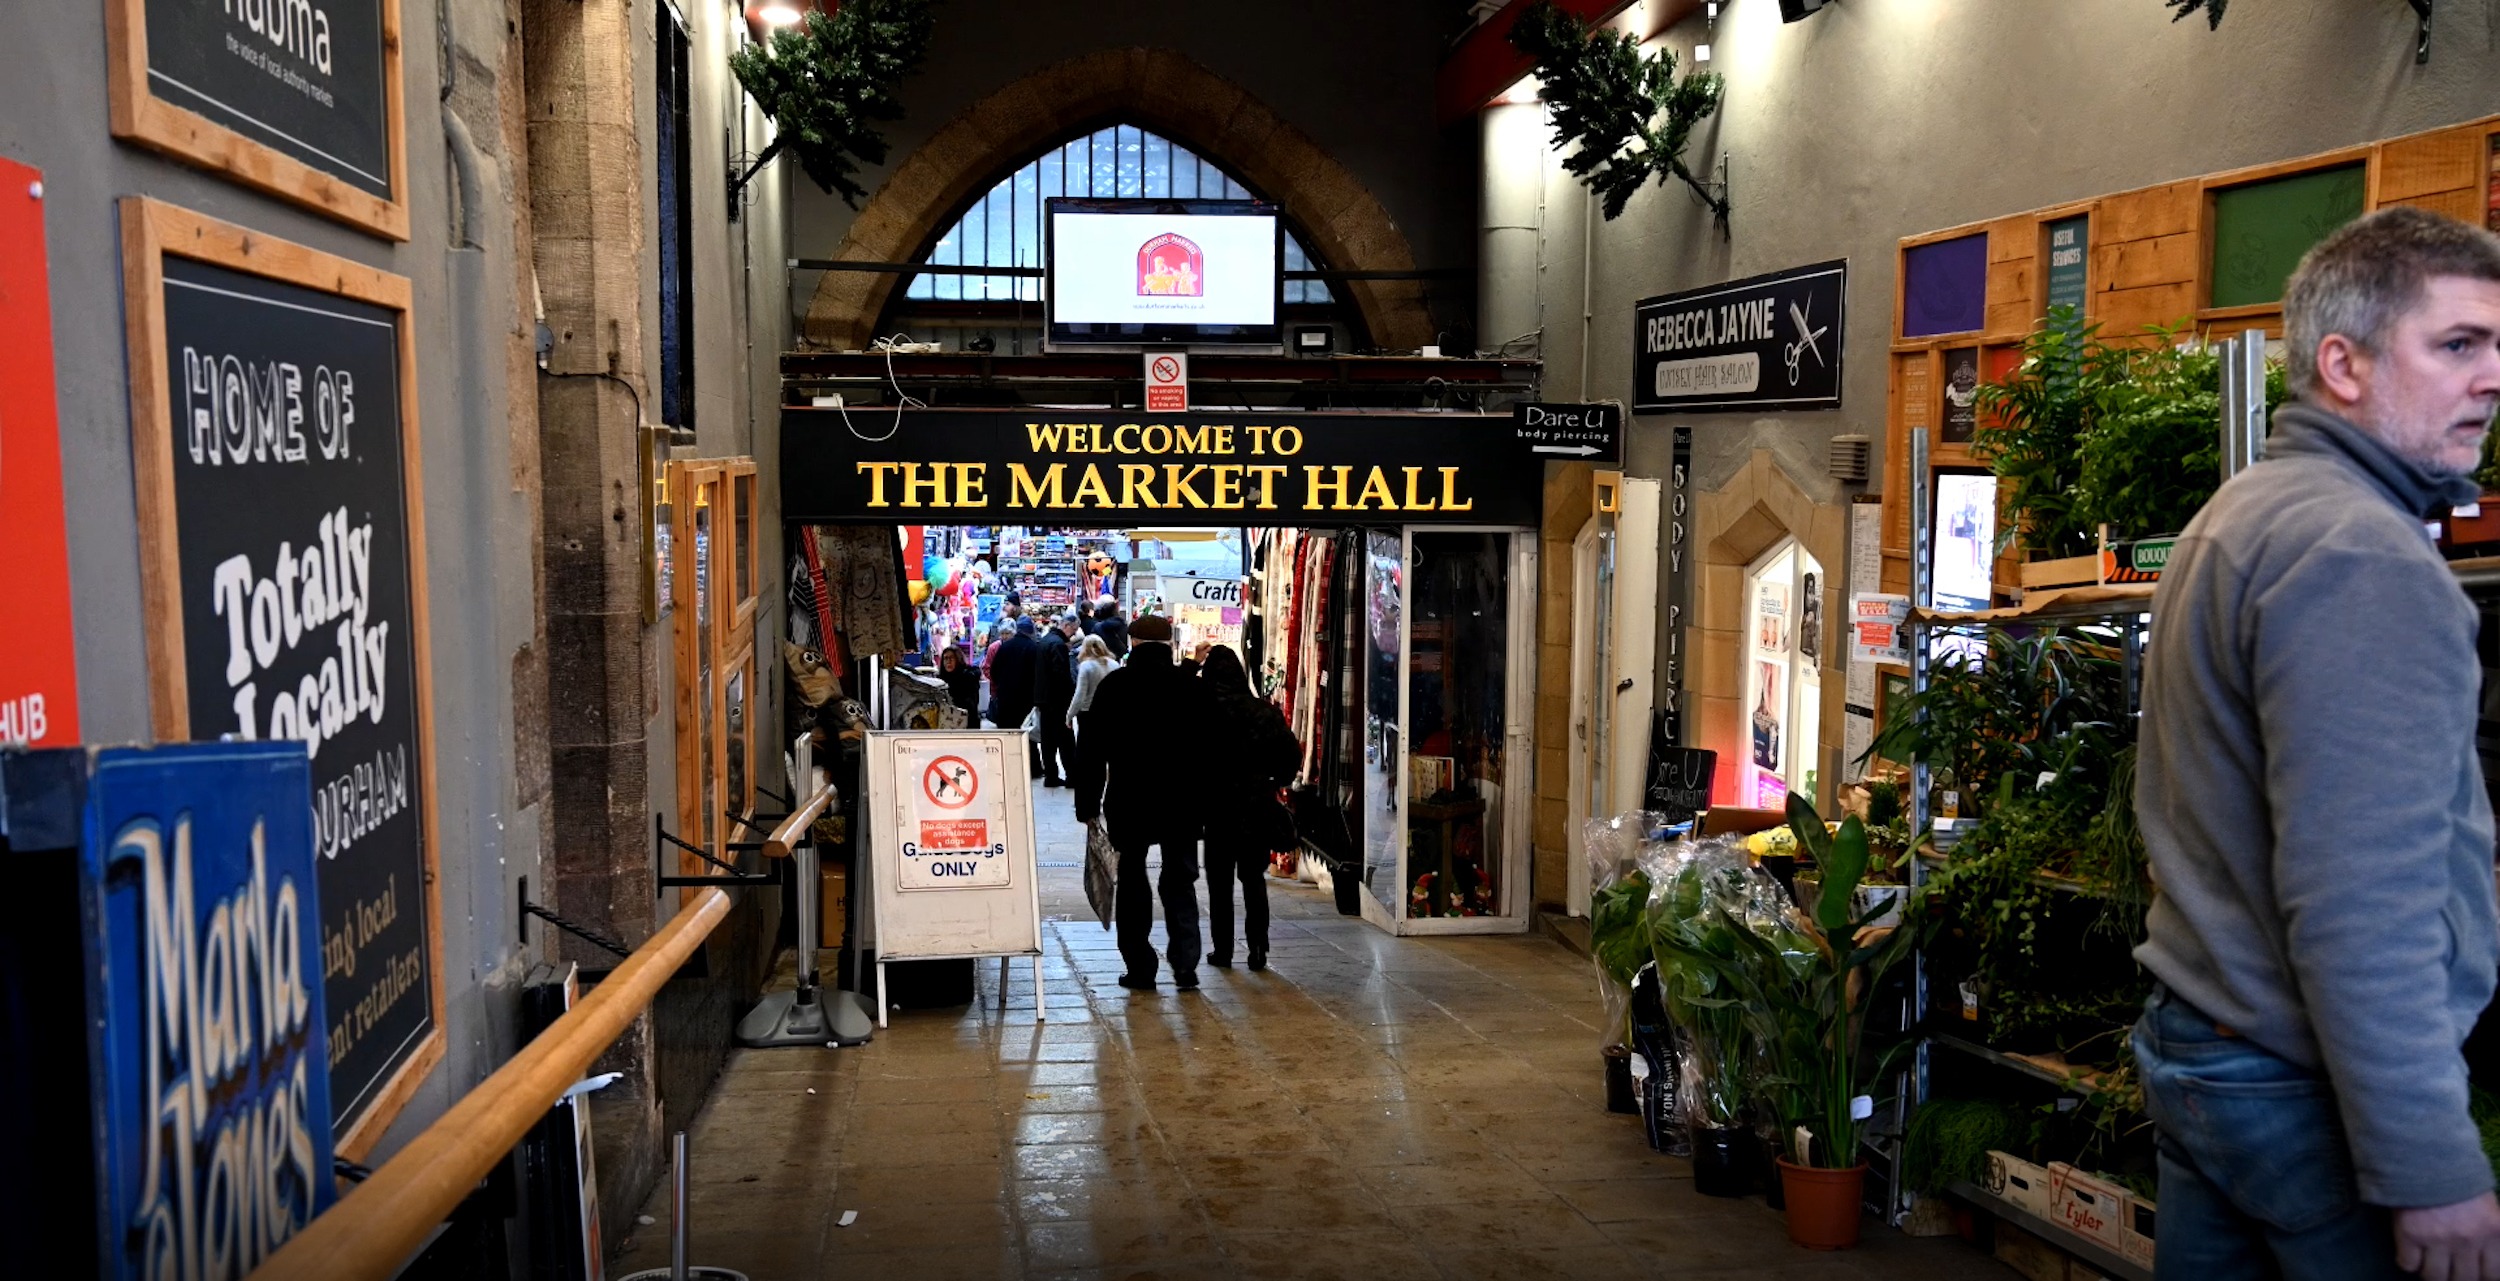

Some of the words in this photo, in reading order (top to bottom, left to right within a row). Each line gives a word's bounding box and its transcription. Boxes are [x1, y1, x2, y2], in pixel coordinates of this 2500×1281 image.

[225, 32, 239, 55] the
[240, 44, 258, 66] voice
[258, 52, 266, 70] of
[266, 55, 282, 79] local
[282, 67, 310, 99] authority
[310, 83, 334, 109] markets
[2052, 247, 2082, 267] SERVICES
[2053, 228, 2074, 247] USEFUL
[1647, 308, 1715, 353] REBECCA
[1717, 297, 1775, 345] JAYNE
[1659, 367, 1692, 390] UNISEX
[1694, 364, 1718, 390] HAIR
[1721, 361, 1755, 385] SALON
[183, 346, 308, 467] HOME
[313, 364, 355, 461] OF
[1525, 406, 1579, 427] Dare
[1585, 409, 1604, 428] U
[1025, 423, 1236, 455] WELCOME
[1246, 425, 1303, 456] TO
[1517, 428, 1548, 440] body
[1554, 430, 1609, 443] piercing
[856, 461, 988, 507] THE
[1006, 462, 1288, 510] MARKET
[1302, 465, 1473, 511] HALL
[1671, 464, 1687, 573] BODY
[2137, 546, 2174, 564] BOUQU
[214, 505, 373, 688] Totally
[1664, 604, 1680, 747] PIERC
[0, 692, 47, 745] HUB
[310, 743, 407, 860] URHAM
[922, 822, 934, 830] No
[935, 822, 956, 831] dogs
[958, 821, 985, 829] except
[933, 829, 976, 837] assistance
[945, 837, 965, 845] dogs
[931, 861, 977, 876] ONLY
[357, 872, 398, 949] local
[354, 945, 421, 1040] retailers
[108, 809, 310, 1222] Marla
[2064, 1200, 2104, 1231] tyler
